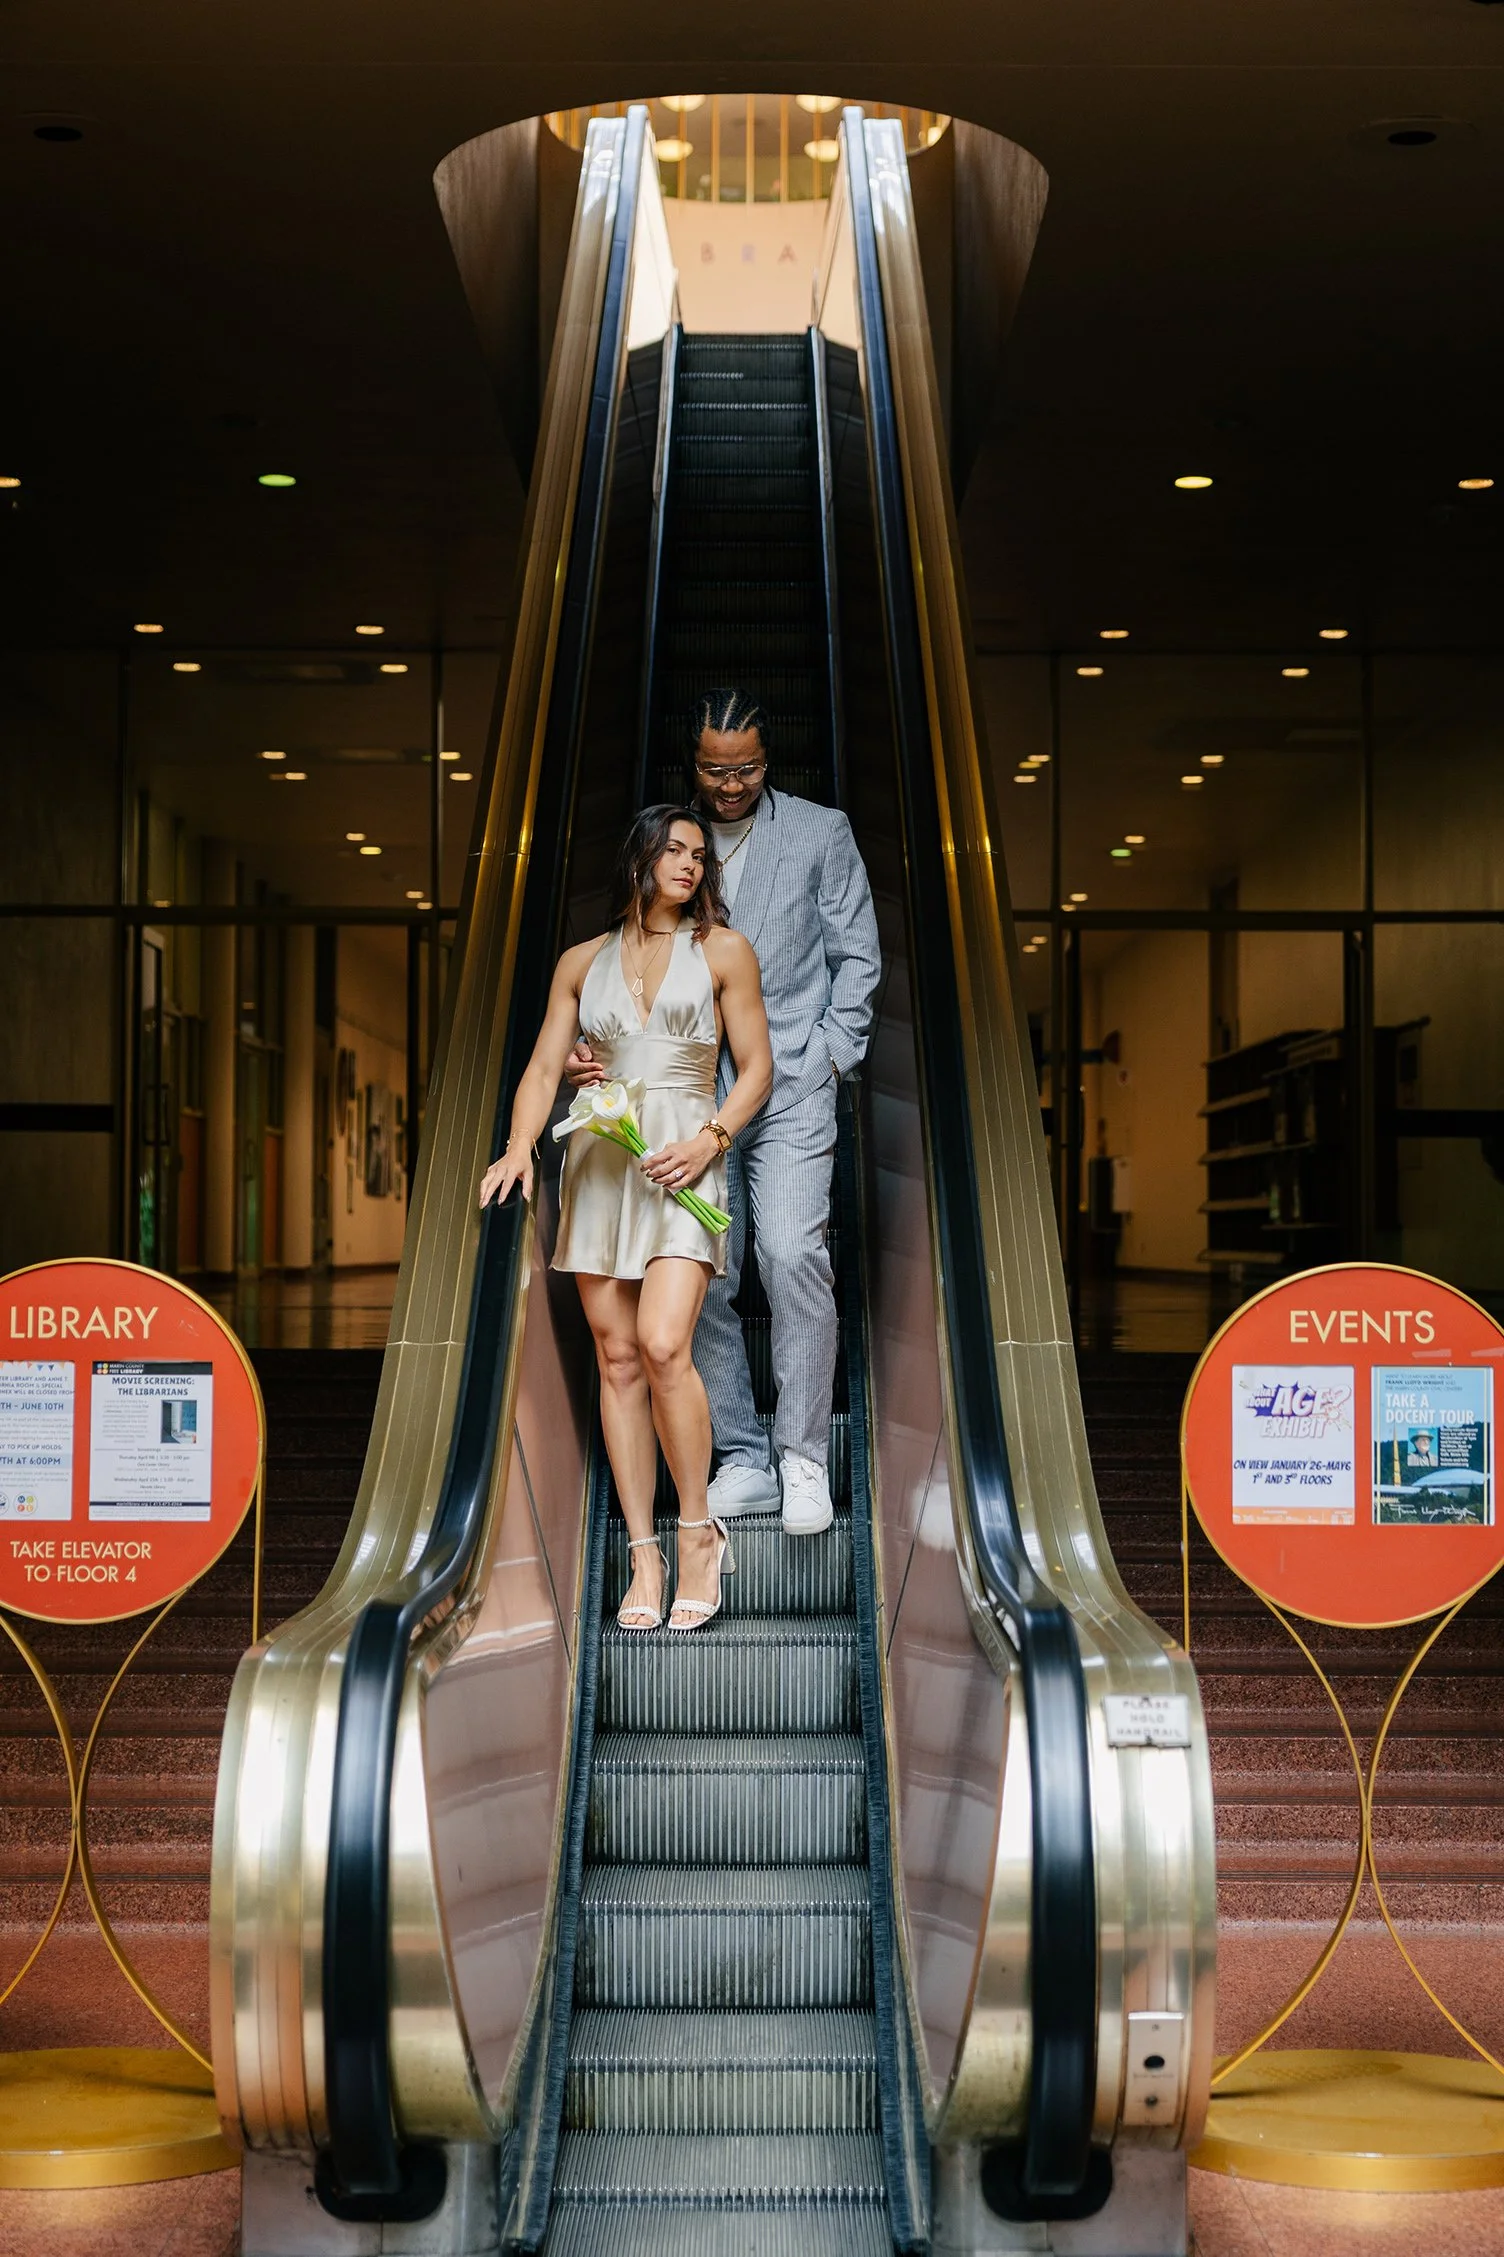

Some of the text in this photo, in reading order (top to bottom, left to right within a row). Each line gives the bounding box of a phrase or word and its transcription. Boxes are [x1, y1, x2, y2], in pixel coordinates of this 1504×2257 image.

[10, 1305, 159, 1339] LIBRARY
[1290, 1310, 1435, 1344] EVENTS
[112, 1377, 195, 1385] MOVIE SCREENING:
[135, 1388, 189, 1396] LIBRARIANS
[21, 1402, 42, 1410] JUNE
[44, 1402, 64, 1410] 10TH
[1385, 1393, 1430, 1408] TAKE A
[1385, 1409, 1475, 1425] DOCENT TOUR
[1261, 1416, 1329, 1438] EXHIBIT
[16, 1457, 26, 1465] AT
[30, 1457, 61, 1465] 6:00PM
[1233, 1460, 1246, 1469] ON
[1248, 1460, 1269, 1469] VIEW
[1270, 1460, 1308, 1470] JANUARY
[1265, 1474, 1283, 1484] AND
[1299, 1474, 1333, 1485] FLOORS
[10, 1541, 152, 1560] TAKE ELEVATOR
[24, 1564, 137, 1583] TO FLOOR 4
